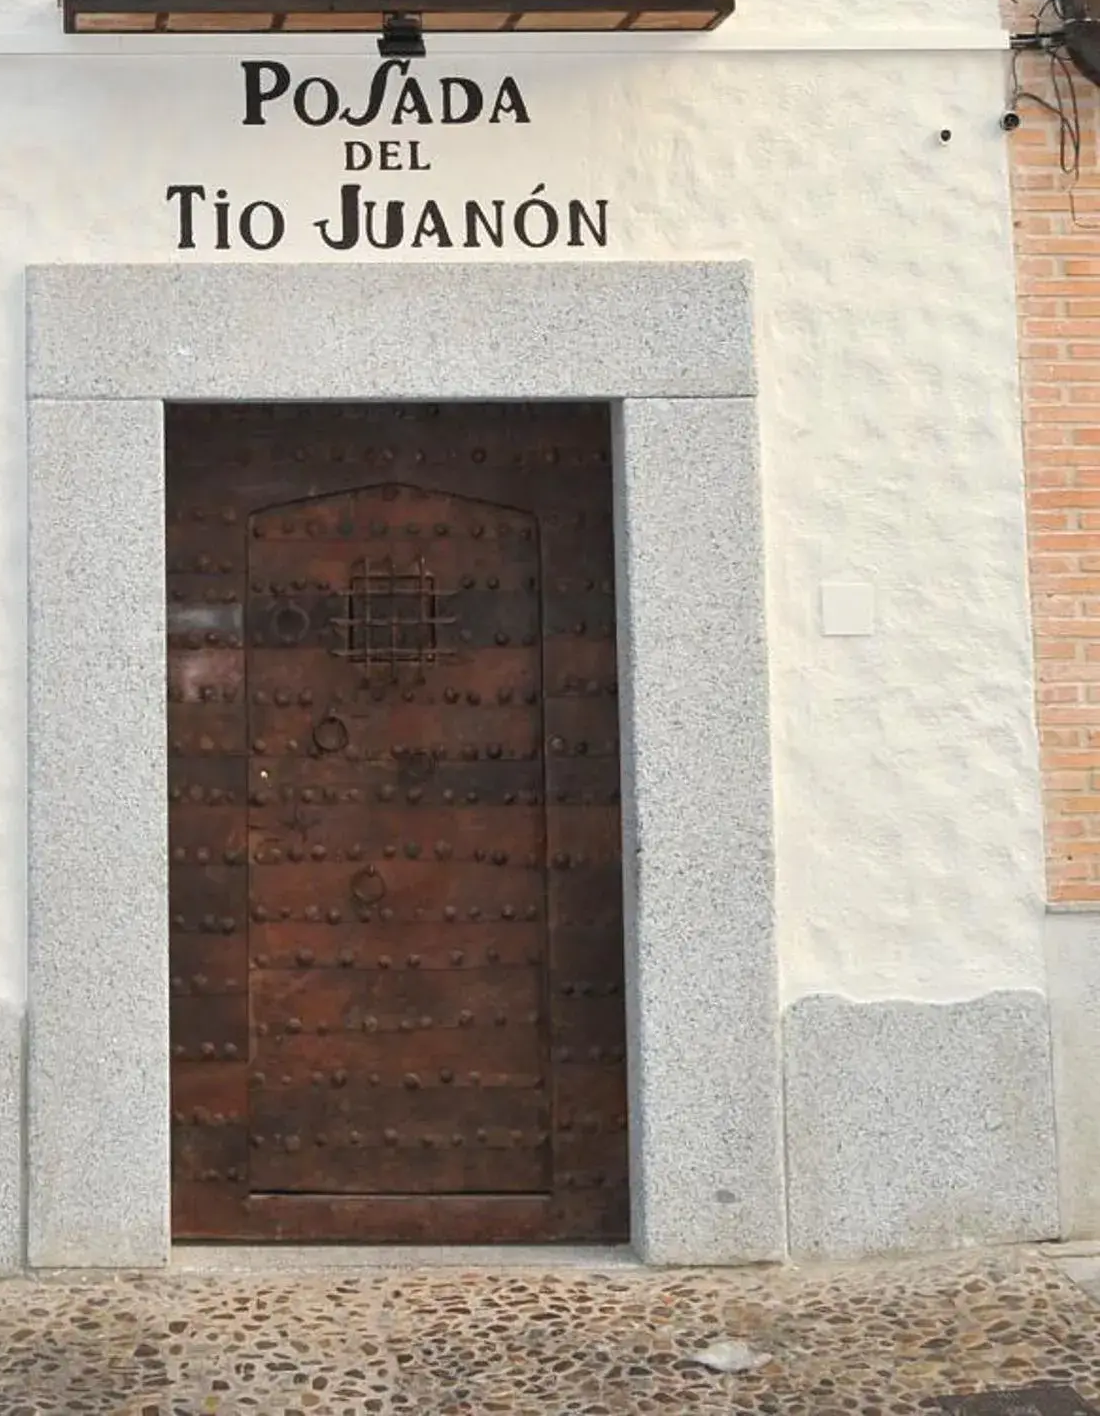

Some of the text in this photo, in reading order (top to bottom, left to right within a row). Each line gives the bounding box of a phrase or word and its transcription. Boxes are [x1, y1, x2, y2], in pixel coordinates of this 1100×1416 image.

[241, 59, 531, 127] POSADA
[344, 141, 431, 171] DEL
[313, 183, 608, 249] JUANÓN
